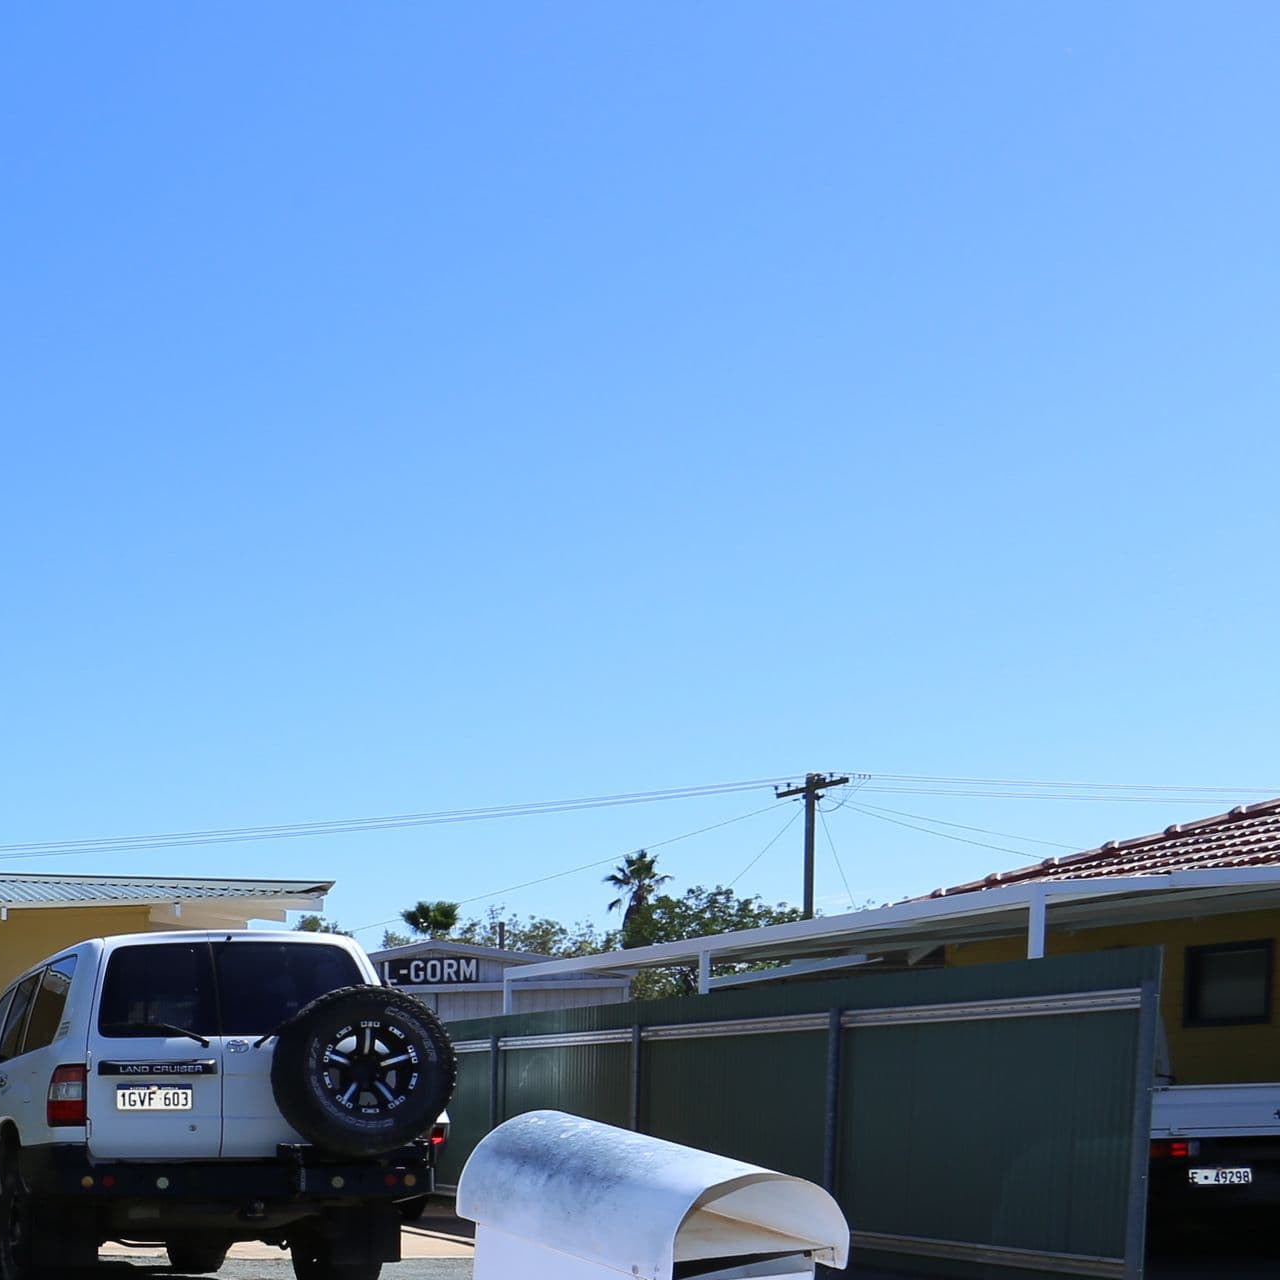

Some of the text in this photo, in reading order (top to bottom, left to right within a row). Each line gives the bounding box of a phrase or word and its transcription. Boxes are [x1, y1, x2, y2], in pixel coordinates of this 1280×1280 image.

[384, 959, 477, 983] L-GORM
[120, 1065, 203, 1073] LAND CRUISER
[121, 1091, 189, 1107] 1GVF 603
[1214, 1170, 1250, 1184] 49298
